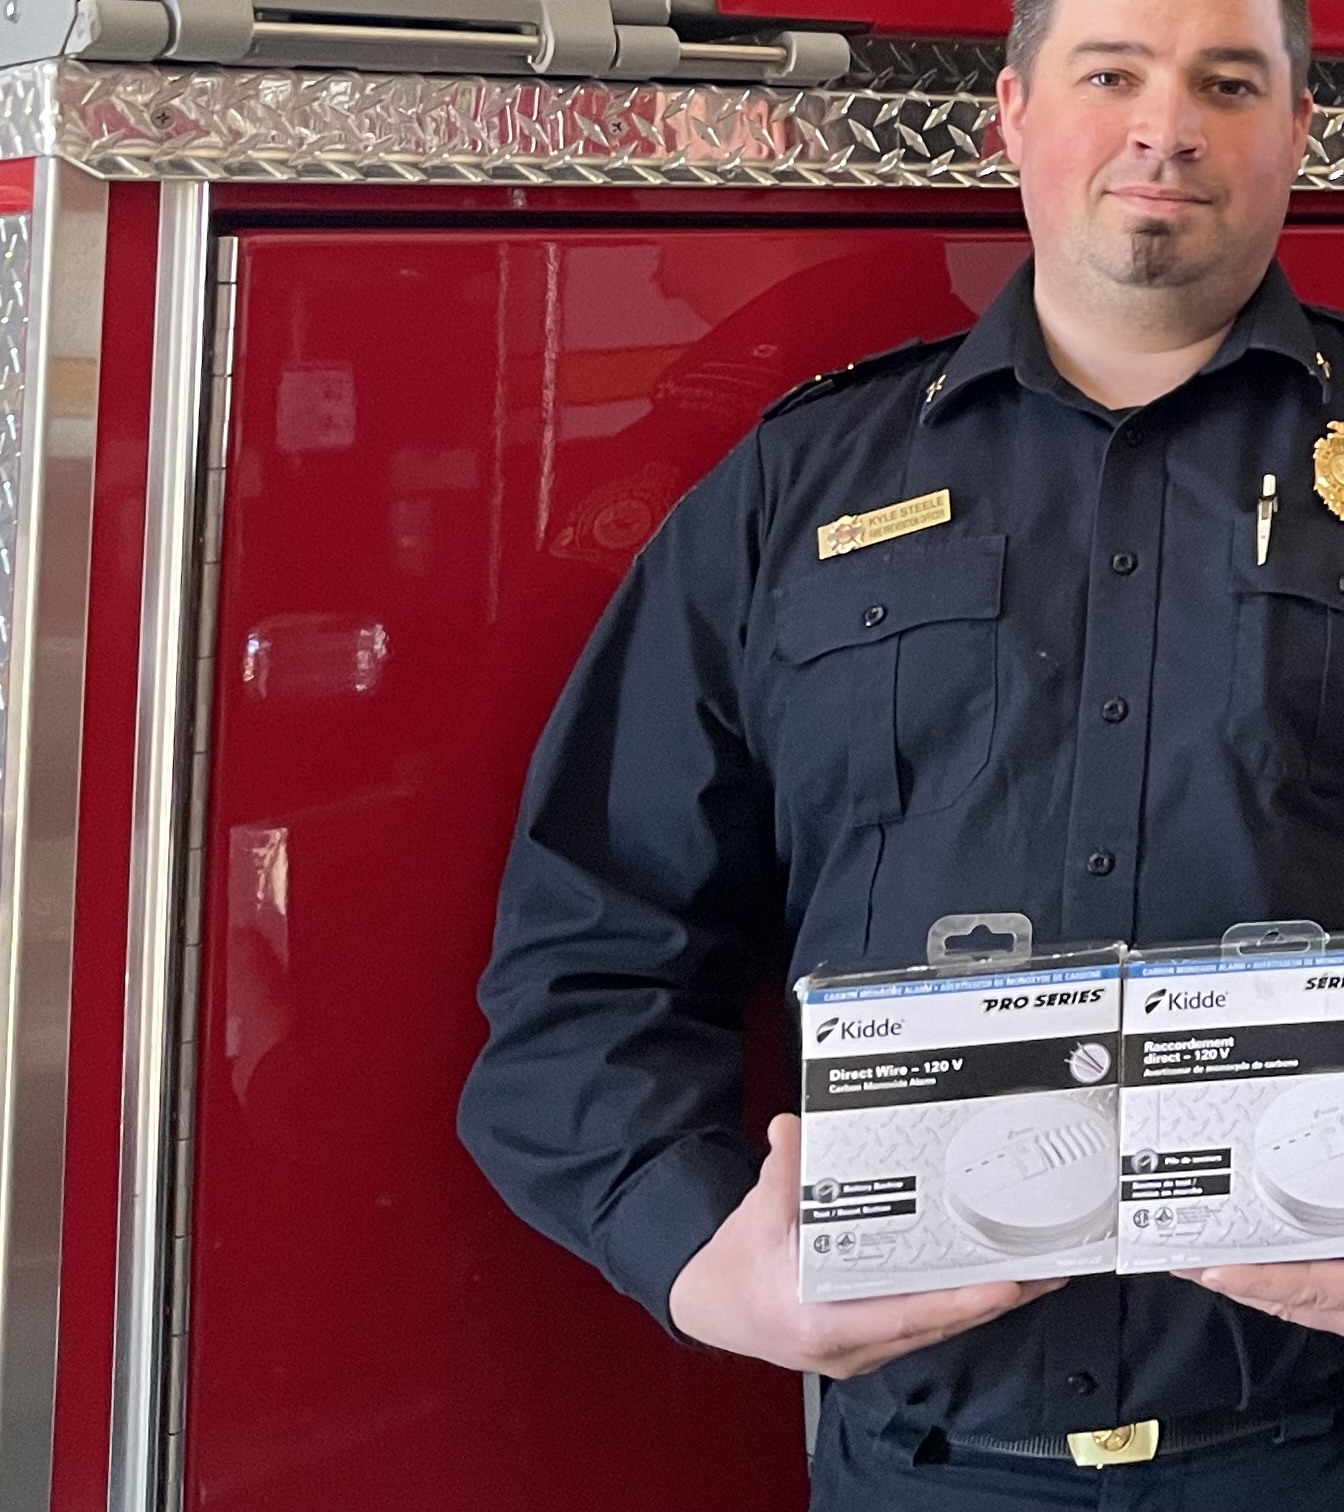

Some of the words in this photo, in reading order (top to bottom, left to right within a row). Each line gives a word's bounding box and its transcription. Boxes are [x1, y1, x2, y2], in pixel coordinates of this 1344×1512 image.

[869, 510, 898, 527] KYLE
[900, 496, 945, 518] STEELE
[983, 996, 1030, 1013] PRO
[1033, 988, 1105, 1008] SERIES
[1168, 991, 1228, 1011] Kidde
[840, 1018, 902, 1040] Kidde
[1143, 1052, 1181, 1065] direct
[1194, 1048, 1218, 1061] 120
[1219, 1047, 1231, 1059] V
[1144, 1037, 1235, 1053] Raccordement
[829, 1068, 873, 1082] Direct
[875, 1064, 908, 1078] Wire
[924, 1059, 949, 1073] 120
[952, 1058, 963, 1070] V
